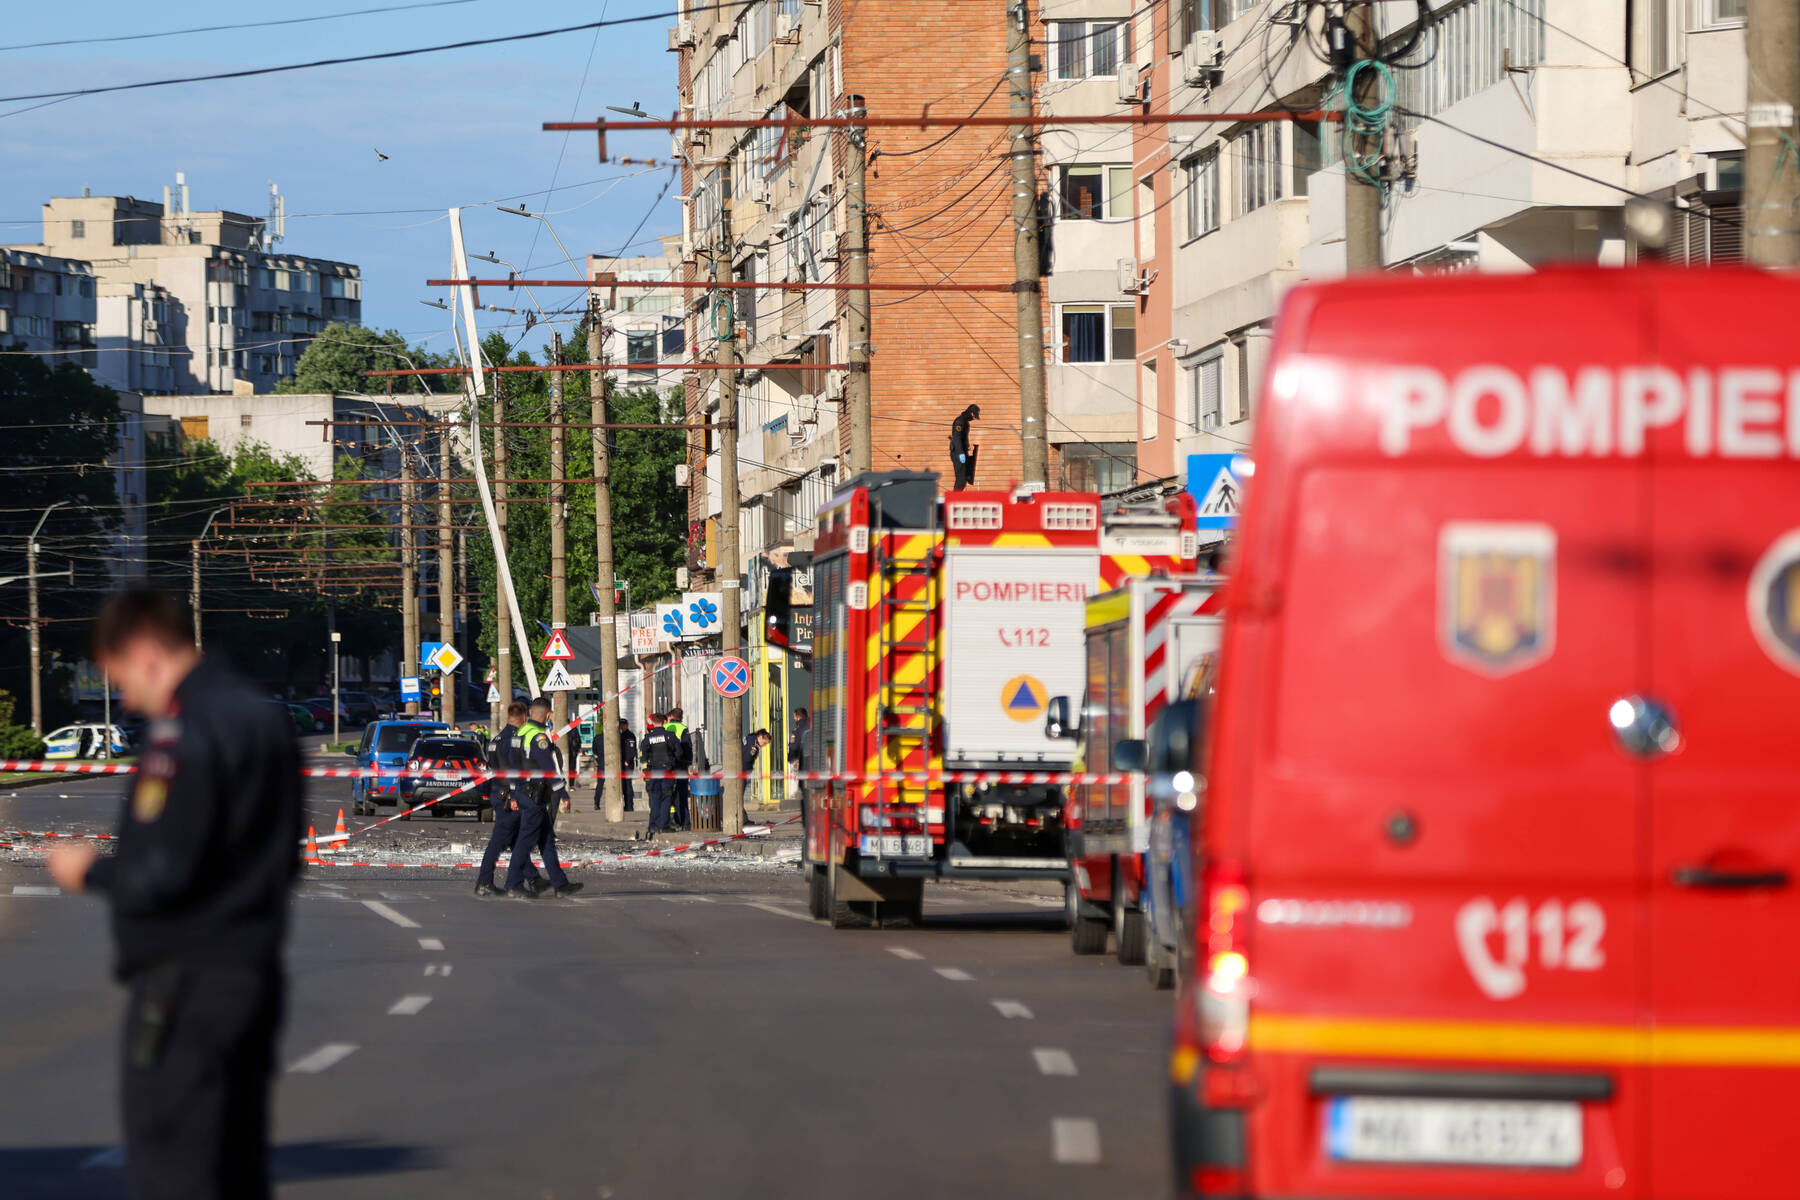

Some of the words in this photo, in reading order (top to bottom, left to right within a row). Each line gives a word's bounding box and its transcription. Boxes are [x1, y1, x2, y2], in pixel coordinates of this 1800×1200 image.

[1377, 364, 1800, 459] POMPIE
[637, 638, 653, 646] FIX
[1013, 628, 1051, 647] 112
[1502, 898, 1606, 971] 112
